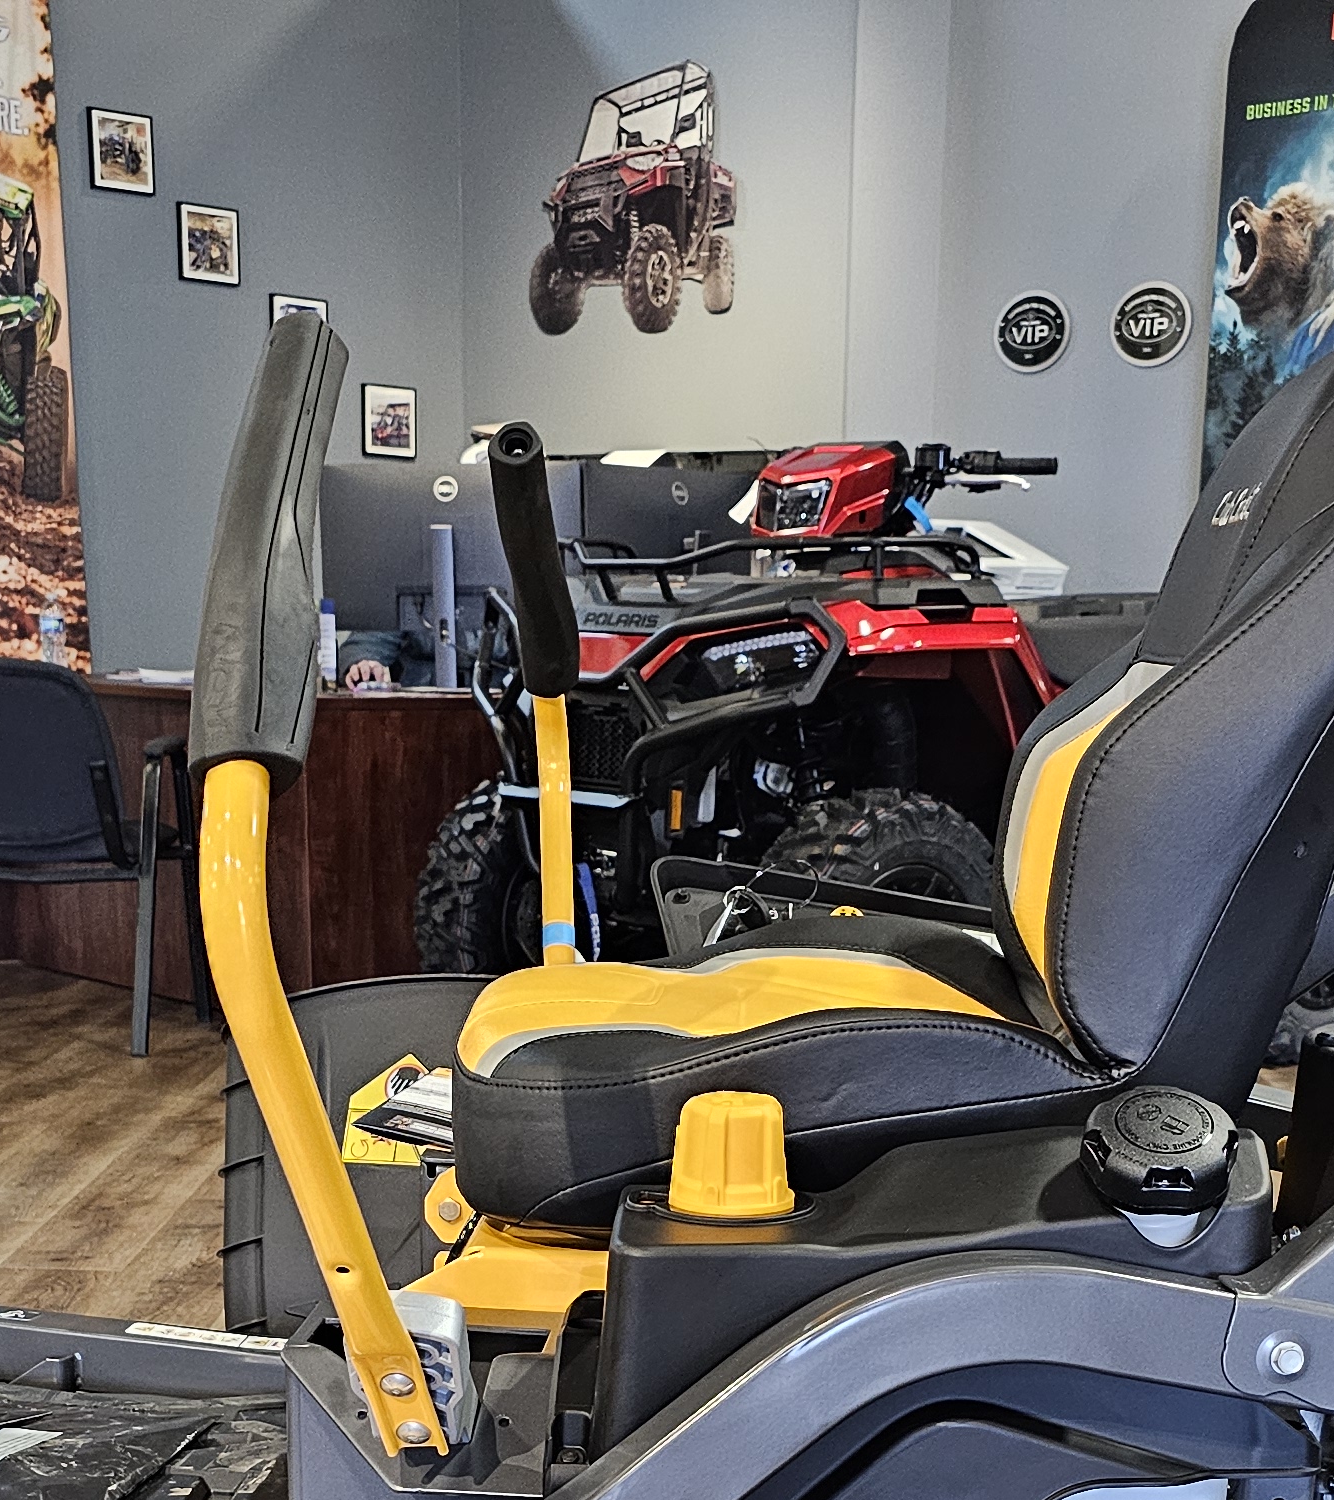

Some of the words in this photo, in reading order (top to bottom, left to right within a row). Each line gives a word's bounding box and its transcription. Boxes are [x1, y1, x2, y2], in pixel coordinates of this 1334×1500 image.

[1246, 97, 1311, 121] BUSINESS
[1314, 94, 1328, 111] IN
[1012, 325, 1050, 344] VIP
[1129, 317, 1169, 337] VIP
[583, 612, 659, 629] POLARIS
